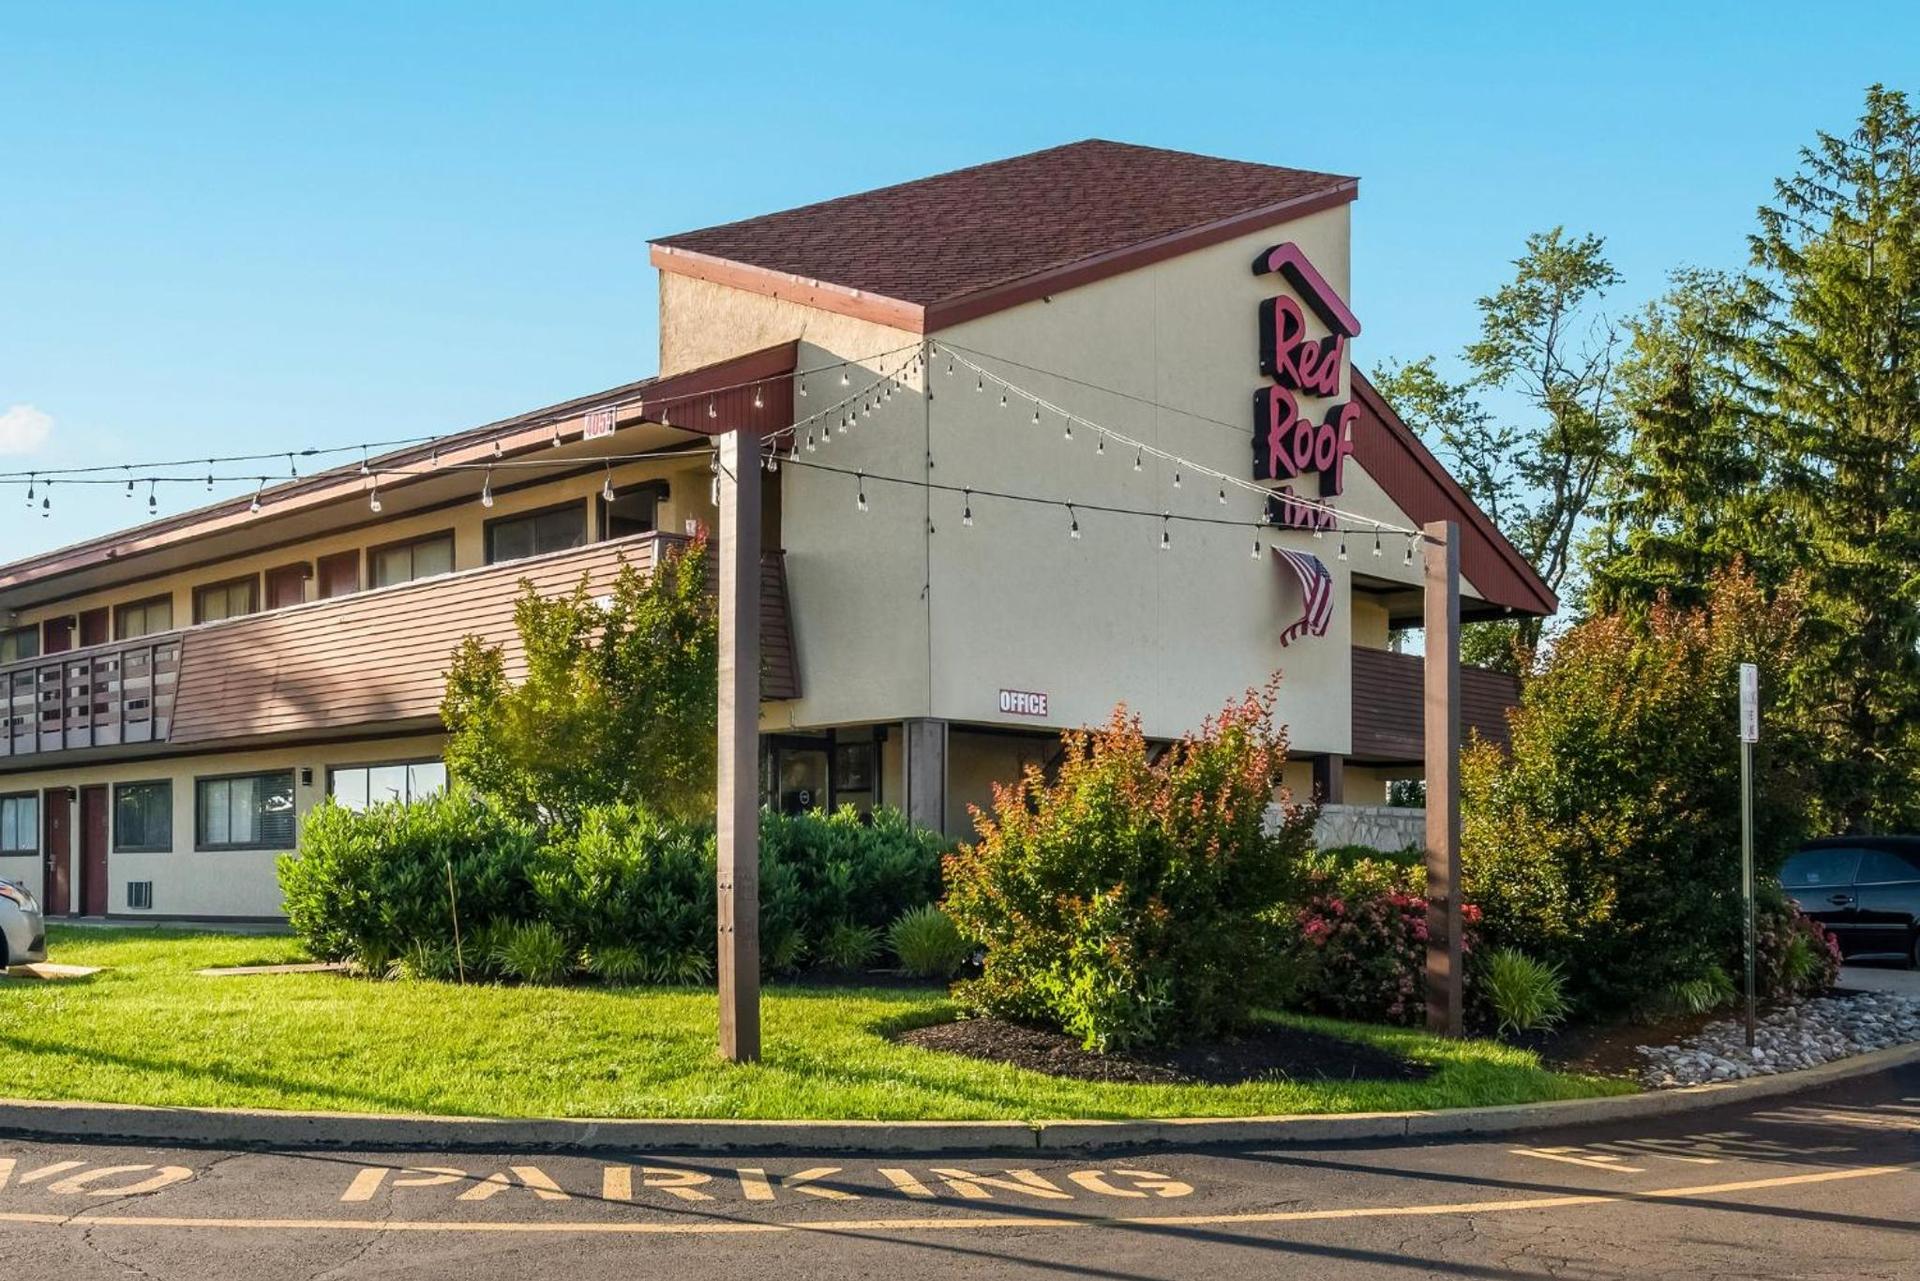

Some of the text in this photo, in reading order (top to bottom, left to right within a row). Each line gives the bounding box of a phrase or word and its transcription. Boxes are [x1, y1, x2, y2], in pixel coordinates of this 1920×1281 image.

[1270, 294, 1345, 396] Red
[1264, 385, 1361, 497] Roof
[1280, 485, 1338, 529] Inn
[1000, 690, 1047, 716] OFFICE
[338, 1165, 1196, 1202] PARKING
